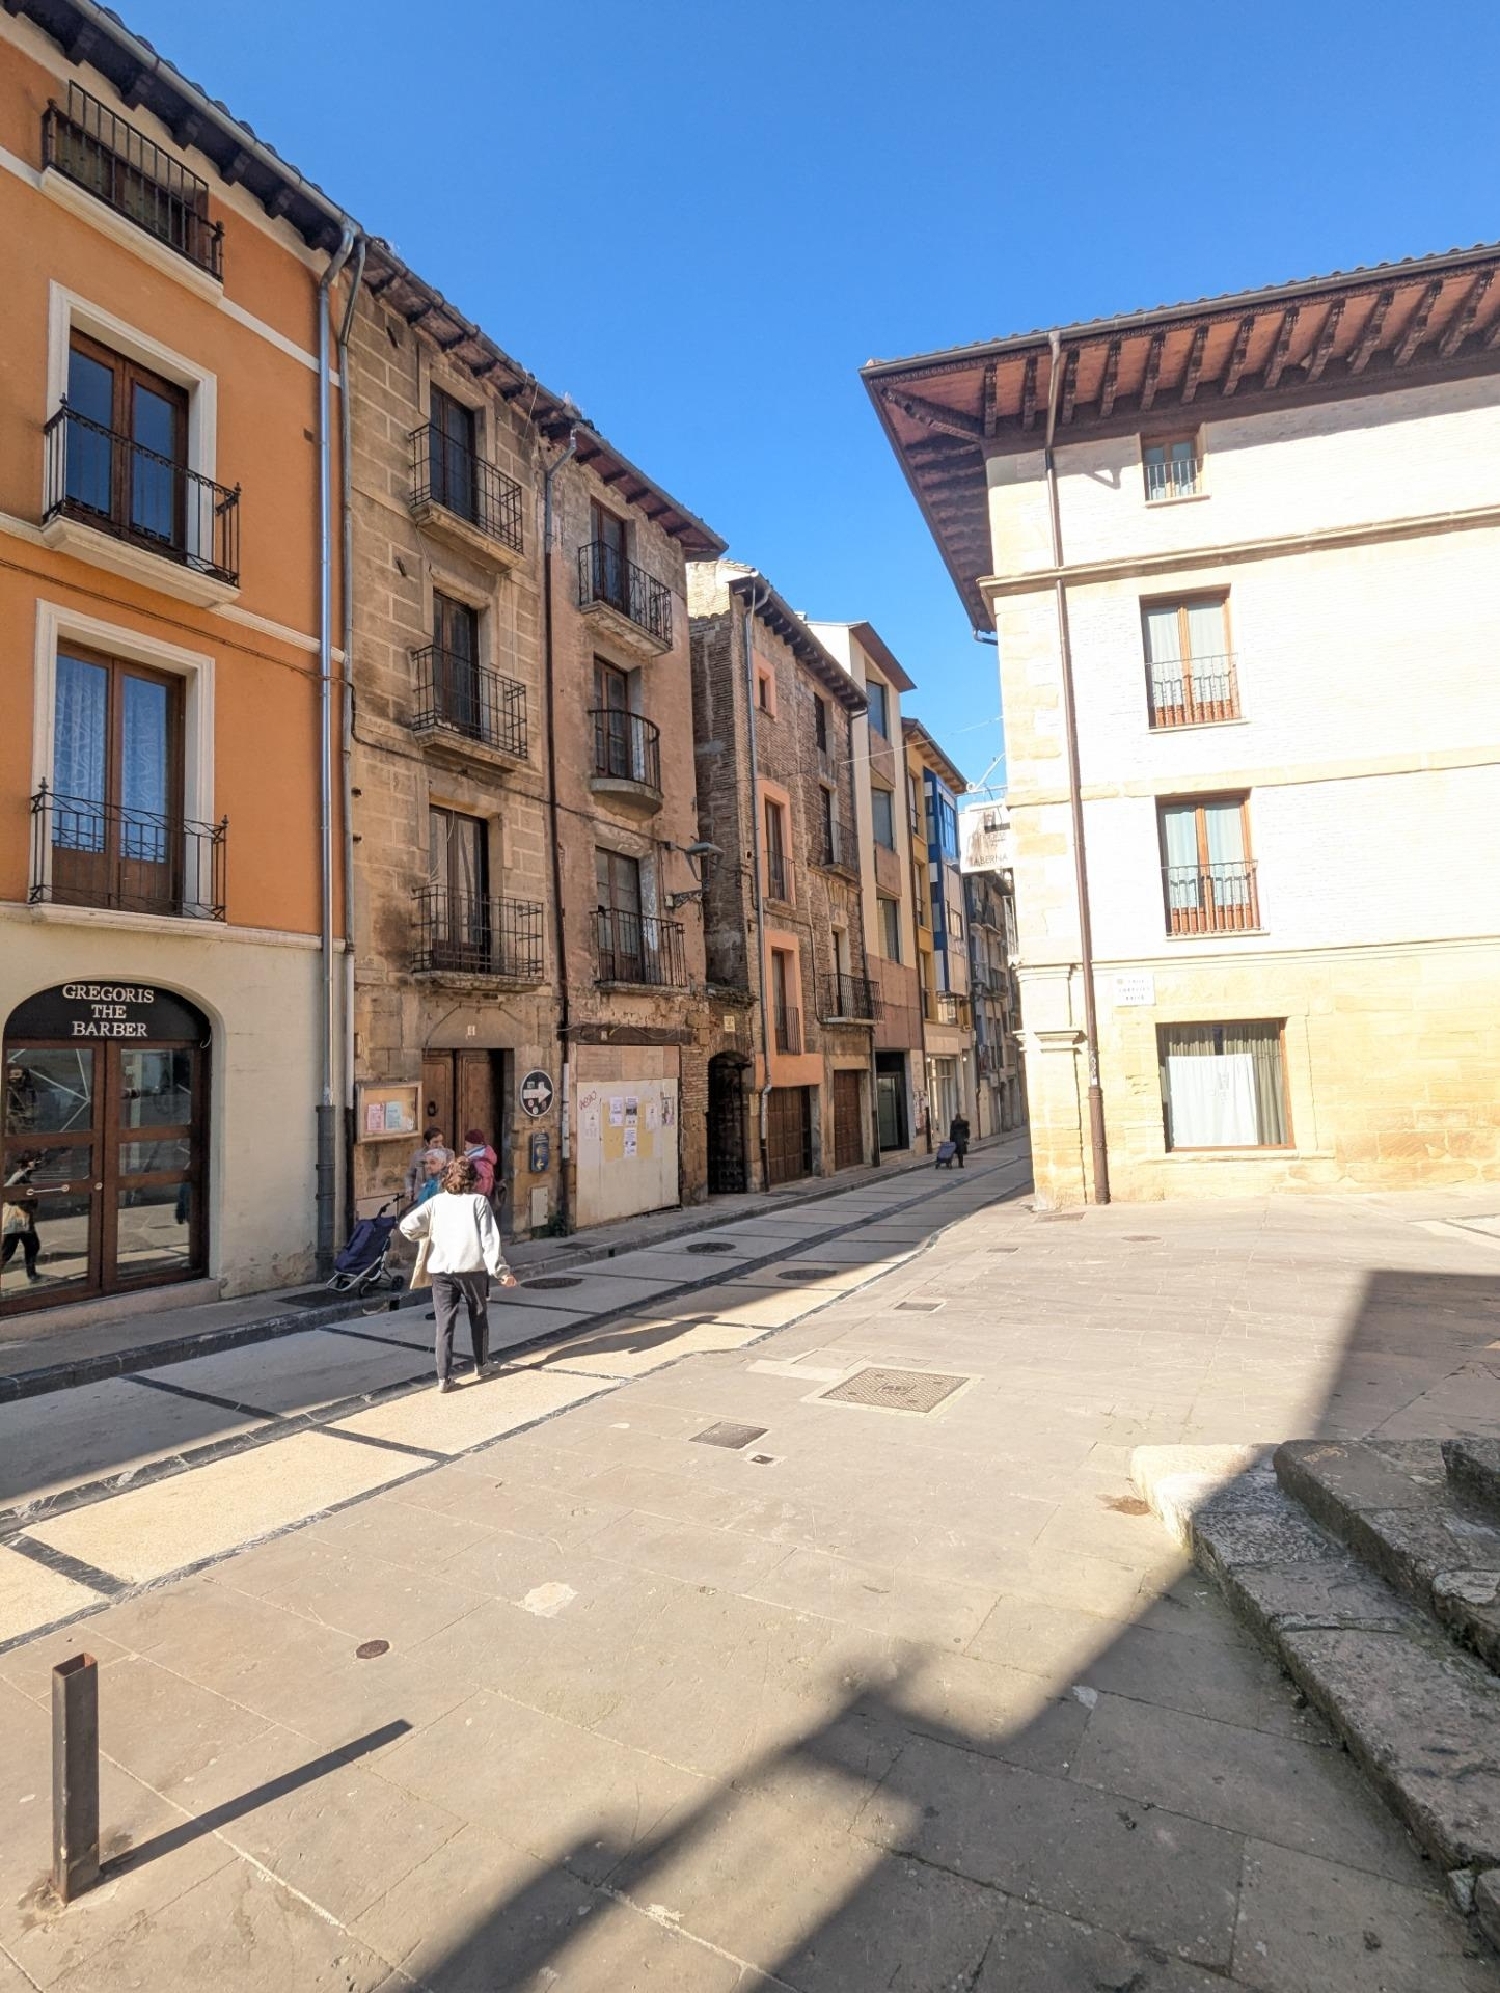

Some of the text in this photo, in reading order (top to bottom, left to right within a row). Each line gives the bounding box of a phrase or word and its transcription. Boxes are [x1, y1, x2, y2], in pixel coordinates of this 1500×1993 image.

[62, 984, 154, 1004] GREGORIS
[91, 1004, 127, 1019] THE
[71, 1020, 148, 1037] BARBER
